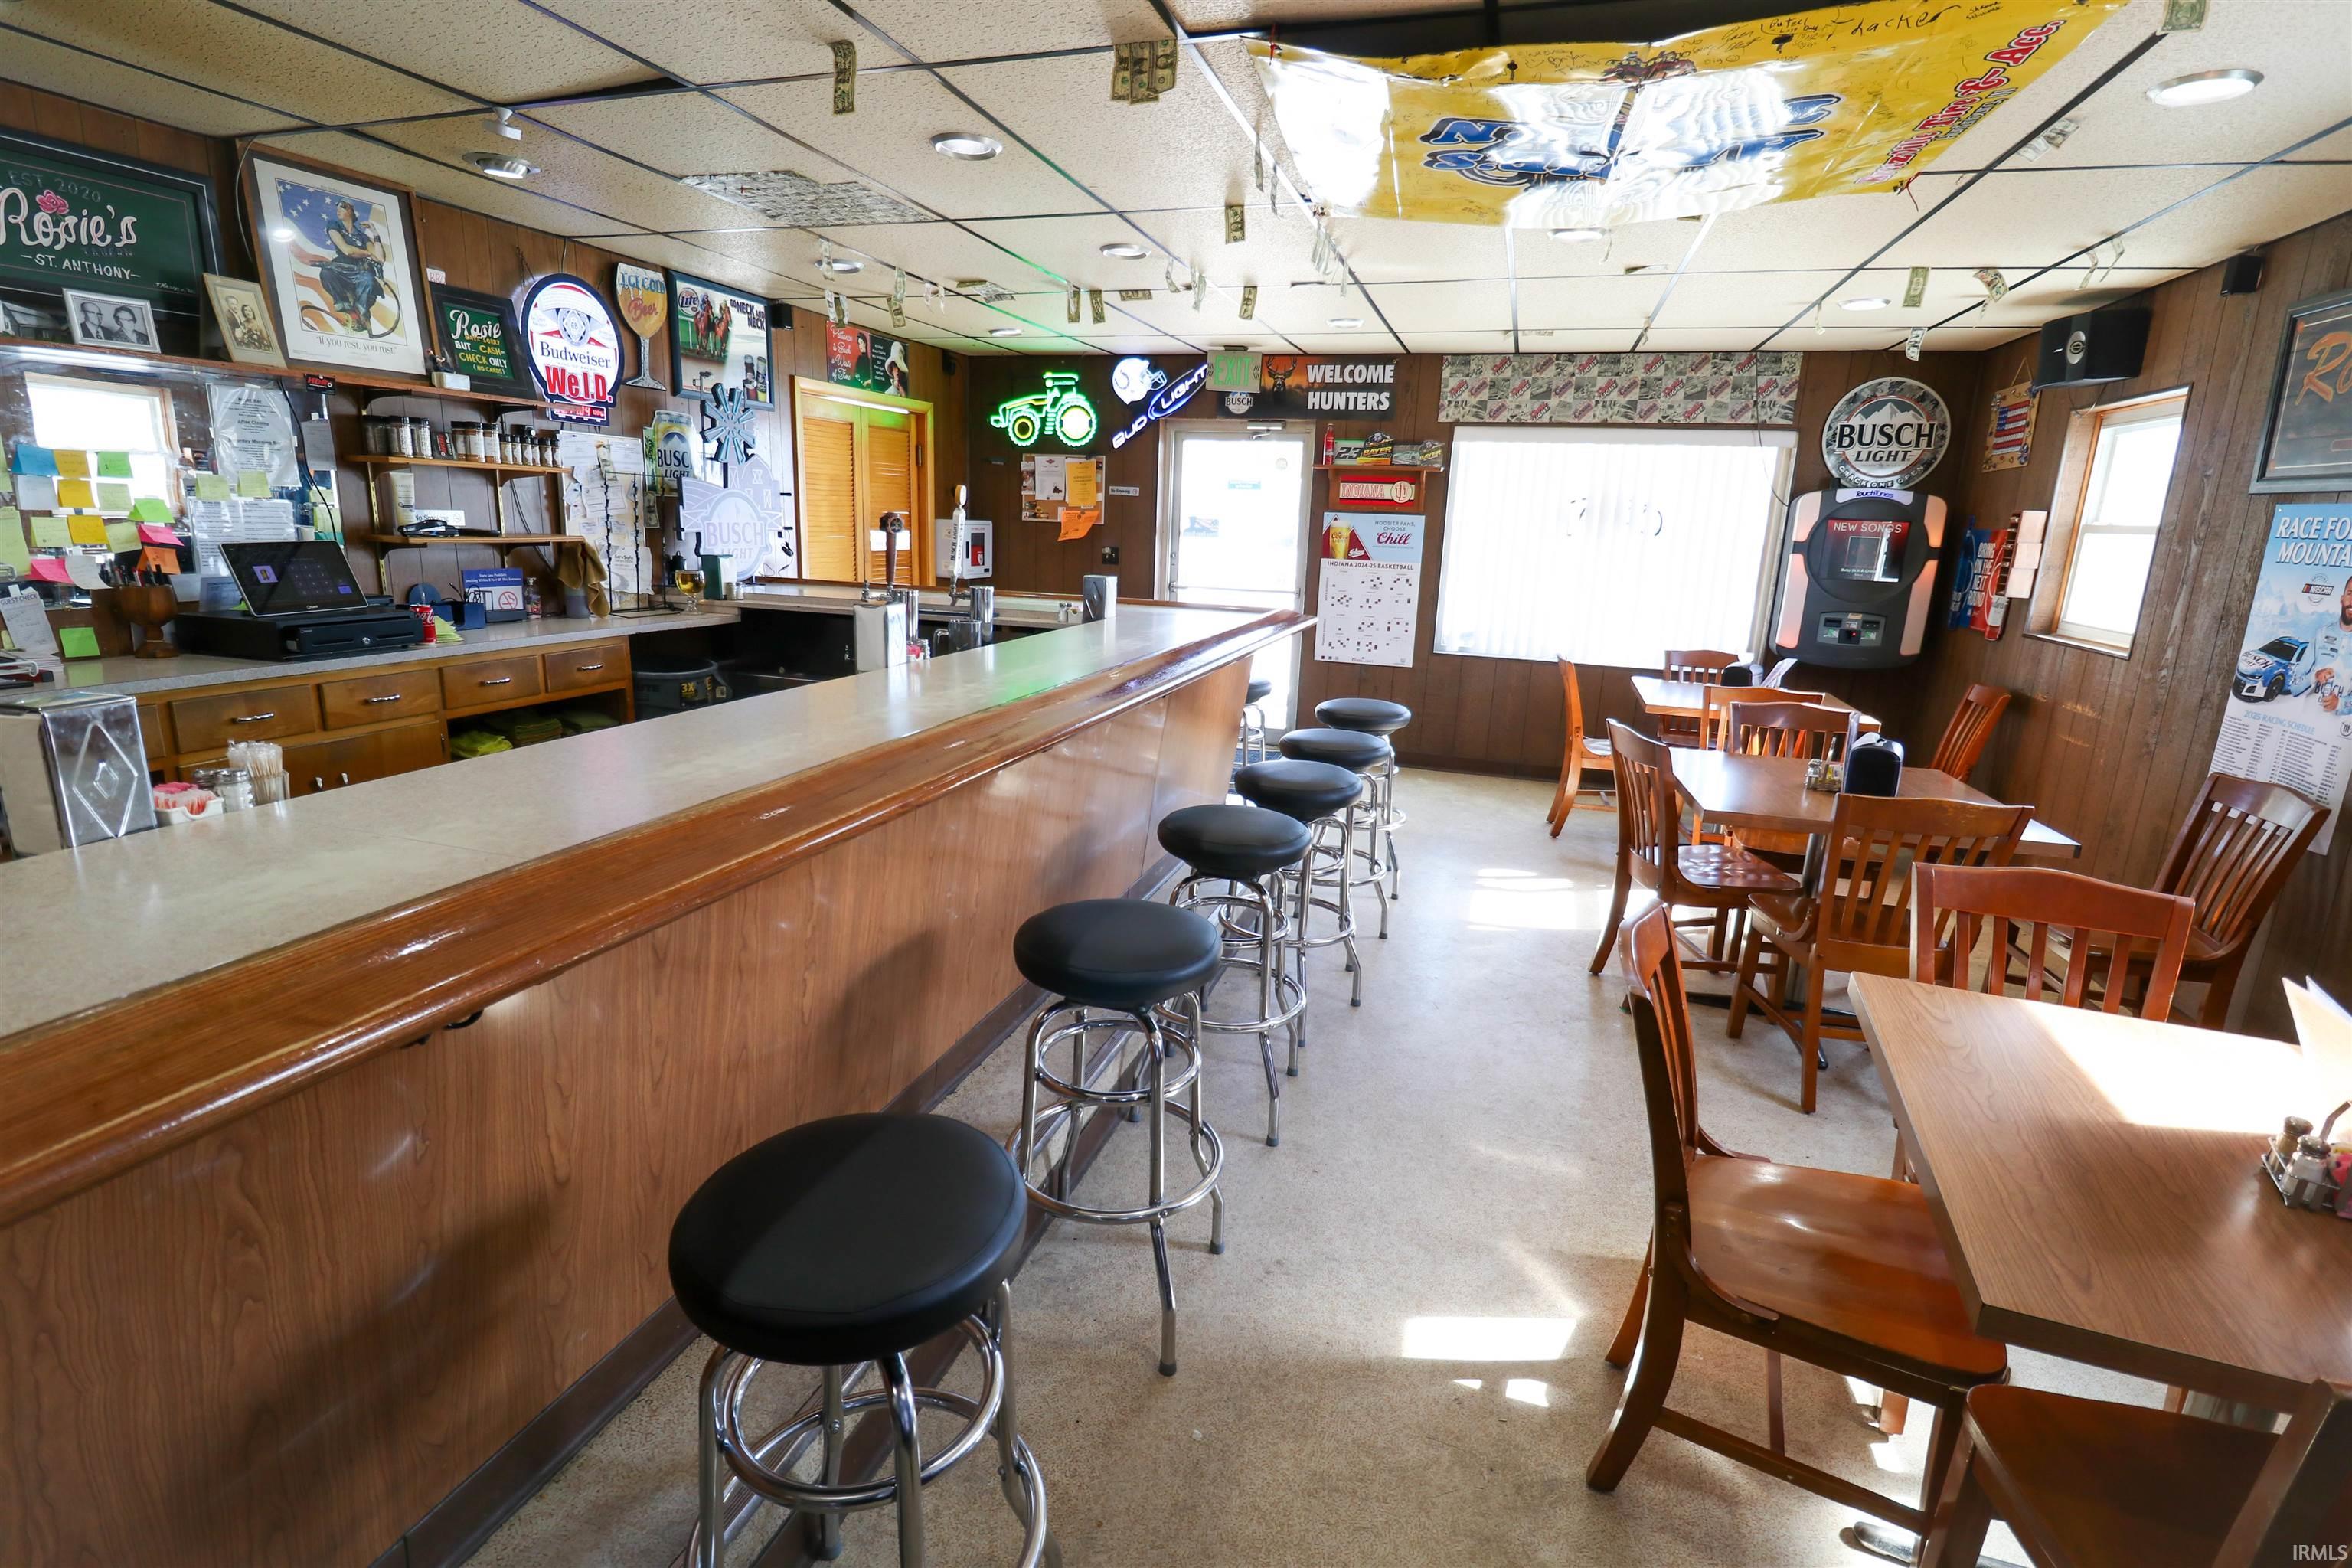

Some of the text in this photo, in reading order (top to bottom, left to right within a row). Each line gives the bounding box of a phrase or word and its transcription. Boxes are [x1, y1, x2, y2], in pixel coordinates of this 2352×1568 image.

[1913, 96, 1982, 132] Tire
[1955, 67, 2010, 98] &
[1984, 20, 2066, 67] Acc.
[8, 170, 101, 203] EST 2020
[0, 187, 137, 250] Rosie's
[34, 253, 131, 280] ST. ANTHONY
[629, 297, 658, 322] Beer
[680, 294, 699, 309] Lite
[737, 302, 755, 318] NECK
[450, 310, 501, 339] Rosie
[747, 315, 766, 331] NECK
[327, 338, 342, 348] you
[363, 344, 377, 353] you
[540, 341, 611, 368] Budweiser
[459, 352, 508, 368] CHECK ONLY
[1214, 354, 1253, 387] EXIT
[1307, 364, 1395, 384] WELCOME
[1160, 364, 1207, 410] LIGHT
[1226, 397, 1253, 407] BUSCH
[1307, 391, 1390, 411] HUNTERS
[1112, 415, 1148, 449] BUD
[1837, 423, 1936, 449] BUSCH
[657, 449, 693, 469] BUSC
[1364, 446, 1392, 456] BAYER
[1854, 450, 1912, 462] LIGHT
[665, 469, 691, 479] LIGHT
[1839, 465, 1924, 488] CRACK ONE OPEN
[1341, 483, 1385, 499] INDIANA
[705, 522, 764, 547] BUSCH
[1834, 522, 1902, 534] NEW SONGS
[2275, 517, 2352, 541] RACE FO
[1377, 532, 1412, 545] Chill
[1, 593, 38, 606] GUEST CHECK
[2309, 586, 2333, 595] NASCAR
[681, 683, 695, 693] 3X
[2243, 710, 2315, 736] 2025 RACING SCHEDULE
